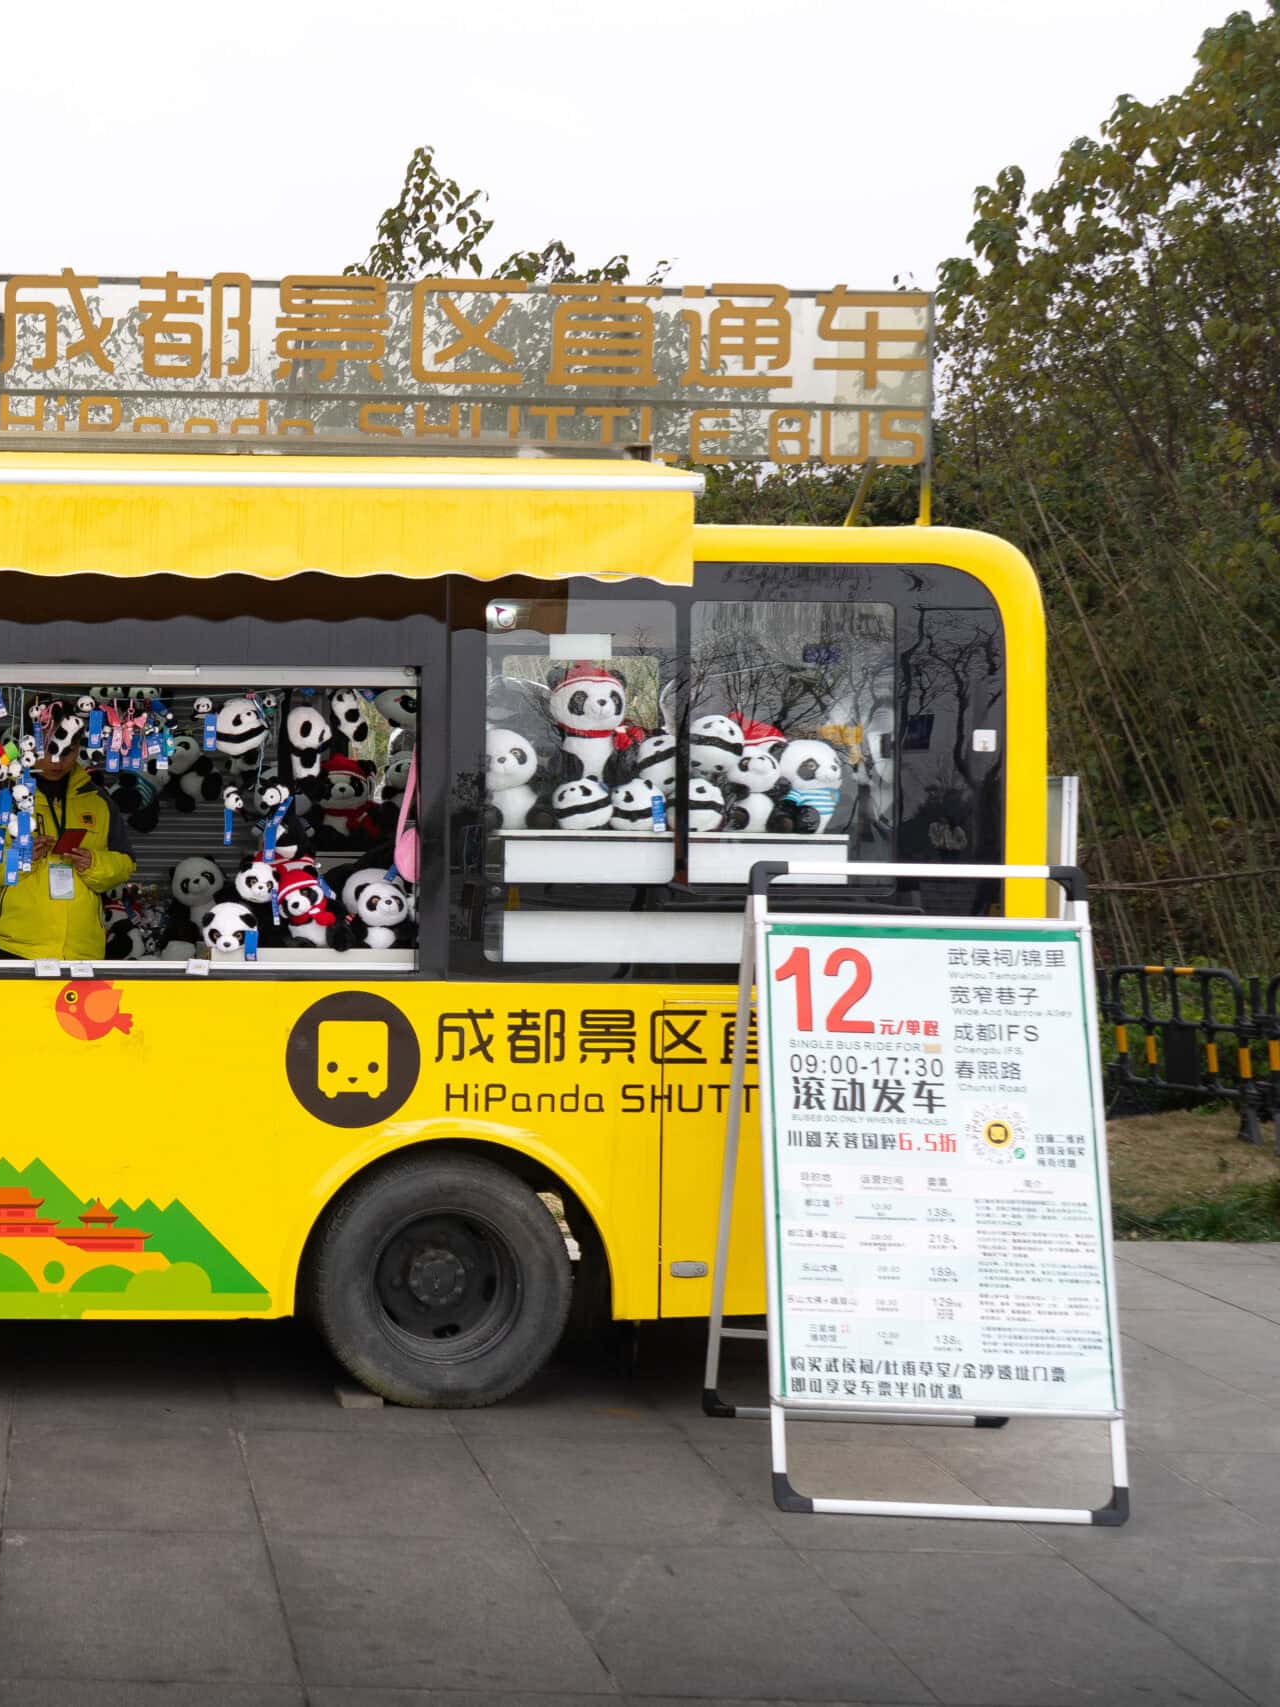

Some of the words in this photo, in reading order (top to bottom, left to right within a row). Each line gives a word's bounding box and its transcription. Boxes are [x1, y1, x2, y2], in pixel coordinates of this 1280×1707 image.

[0, 267, 927, 389] 成都景区直通车
[769, 410, 927, 464] BUS
[947, 948, 1066, 967] 武侯祠/锦里
[950, 986, 1039, 1005] 宽窄巷子
[954, 1022, 1039, 1042] 成都IFS
[789, 1038, 833, 1050] SINGLE
[836, 1040, 861, 1051] BUS
[863, 1041, 893, 1052] RIDE
[896, 1042, 921, 1053] FOR
[790, 1053, 943, 1078] 09:00-17:30
[955, 1060, 1021, 1081] 春熙路
[445, 1083, 605, 1112] HiPanda
[792, 1076, 947, 1114] 滚动发车
